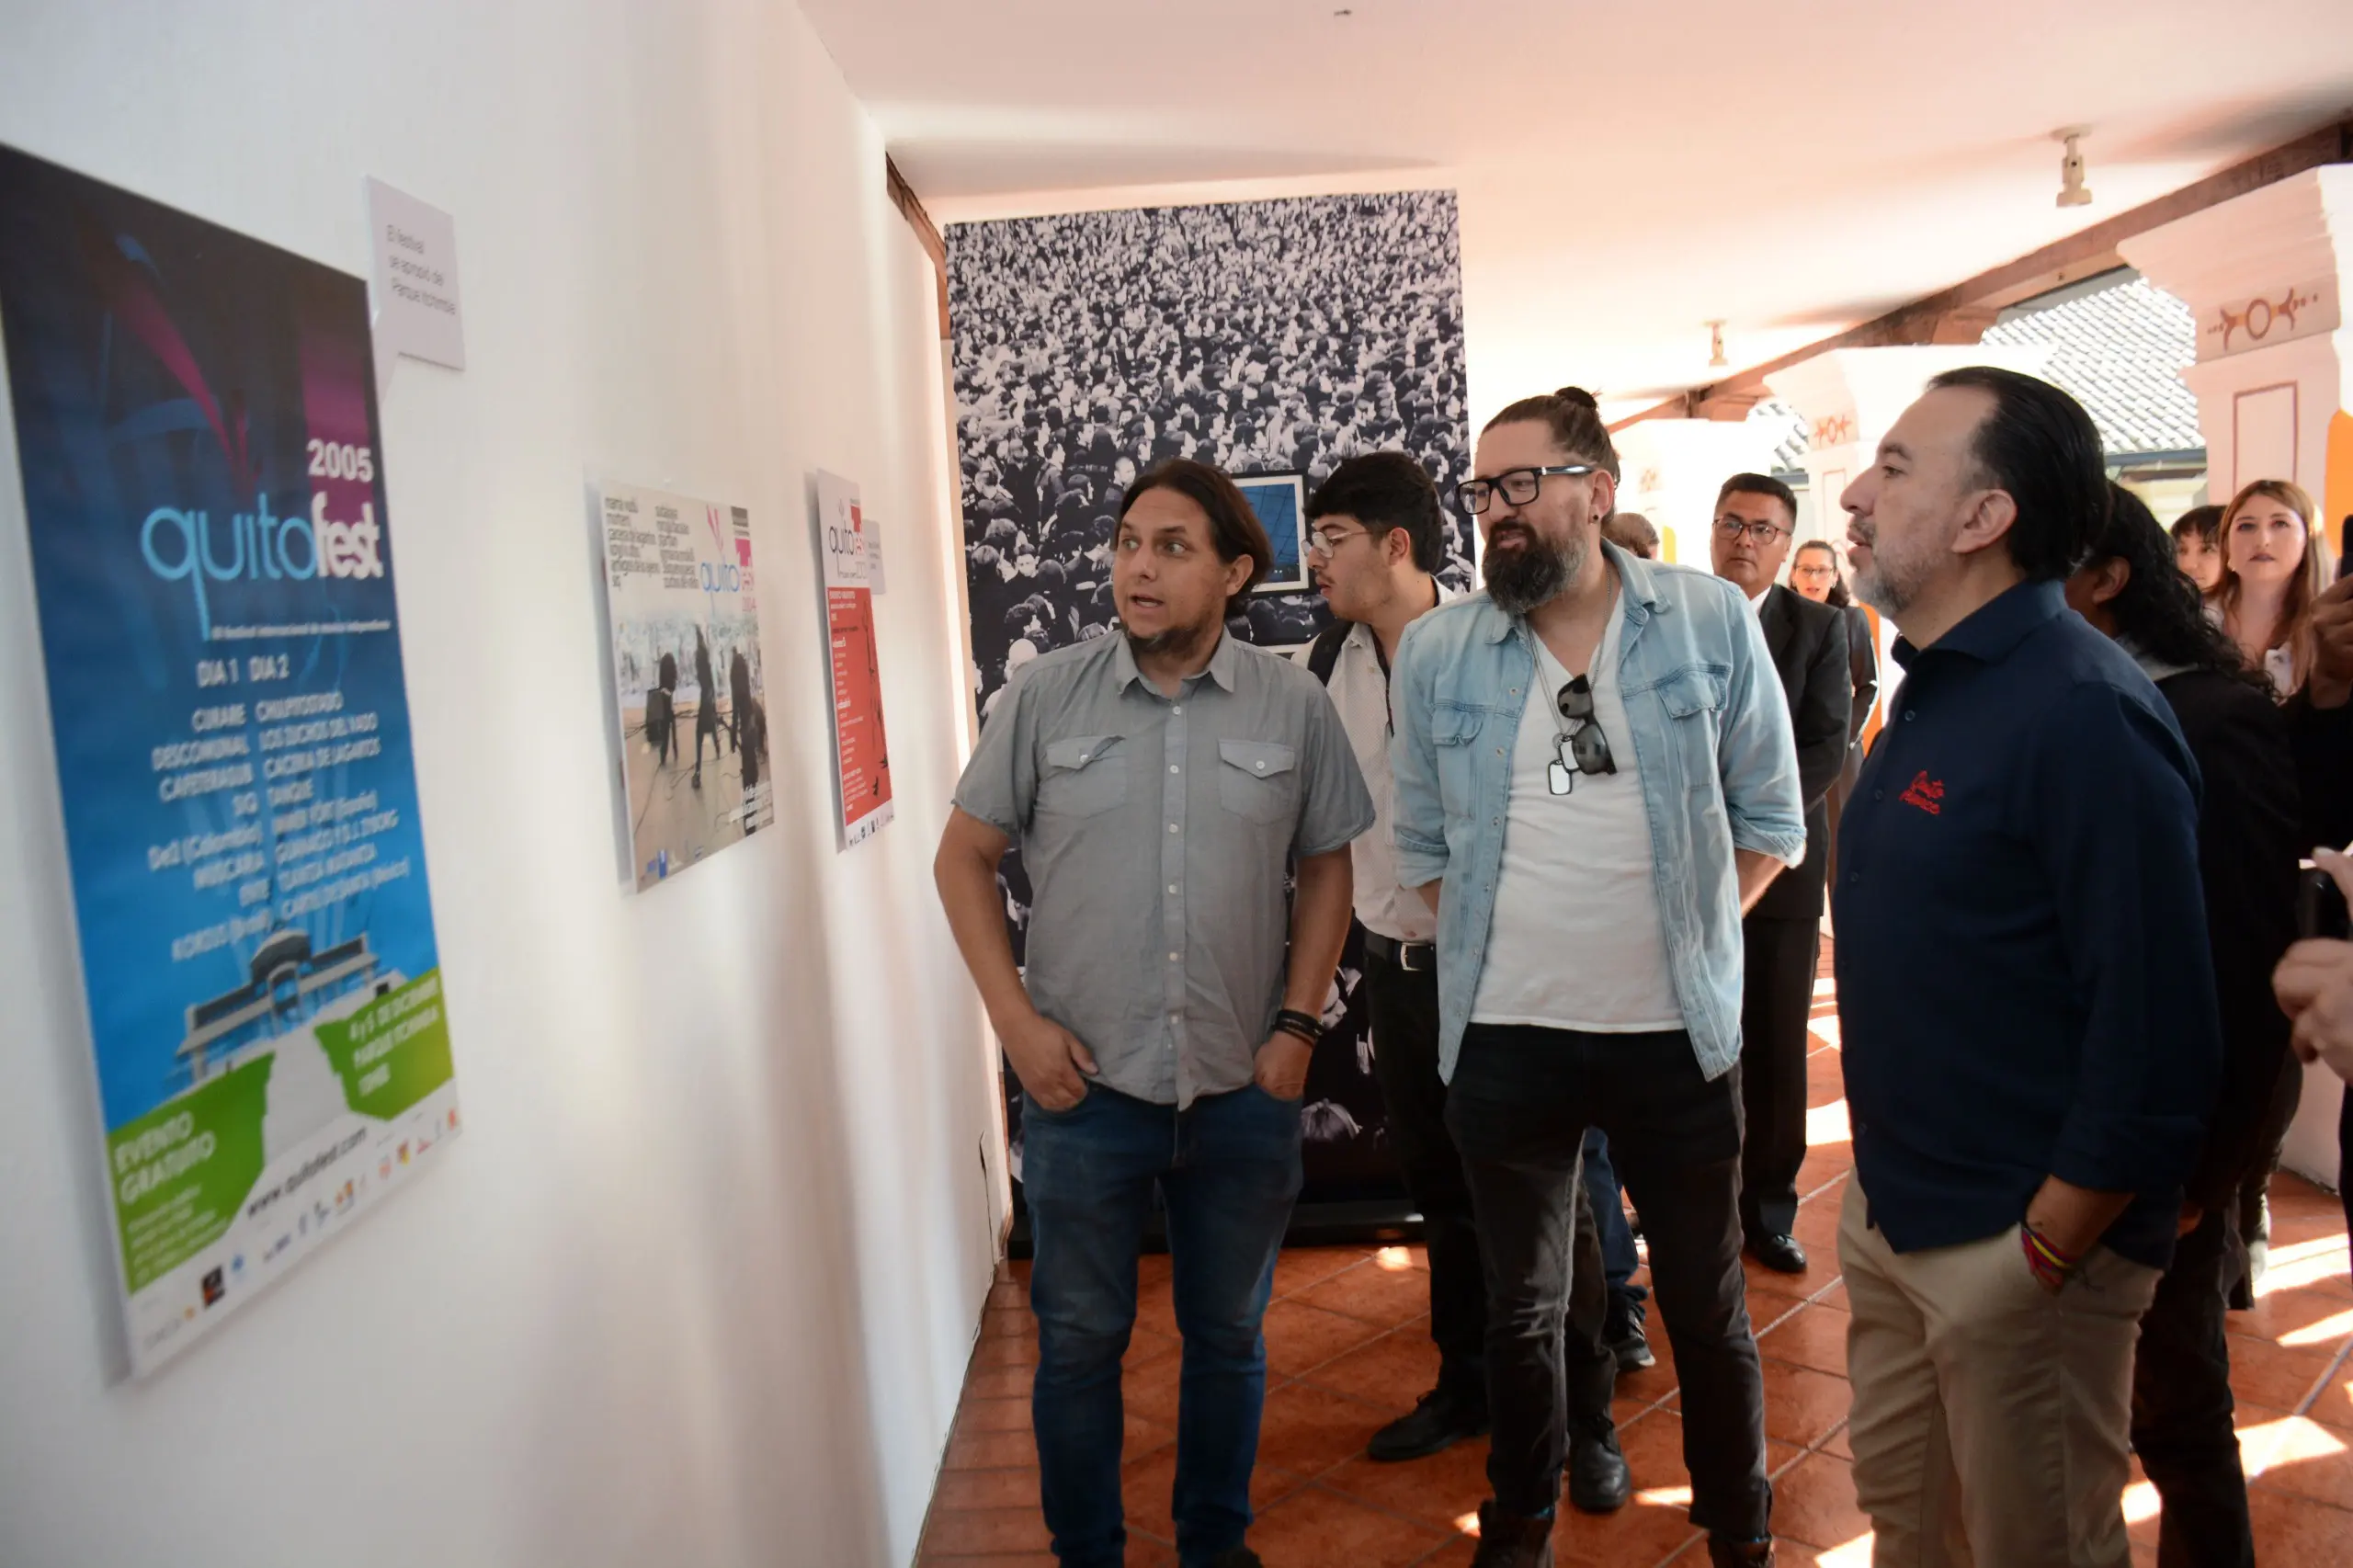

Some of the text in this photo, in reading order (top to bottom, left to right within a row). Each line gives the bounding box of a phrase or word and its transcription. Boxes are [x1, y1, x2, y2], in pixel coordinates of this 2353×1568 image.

[306, 438, 374, 483] 2005
[197, 657, 239, 687] DIA 1
[248, 653, 290, 682] DIA 2
[115, 1110, 195, 1174] EVENTO
[120, 1130, 217, 1204] GRATUITO
